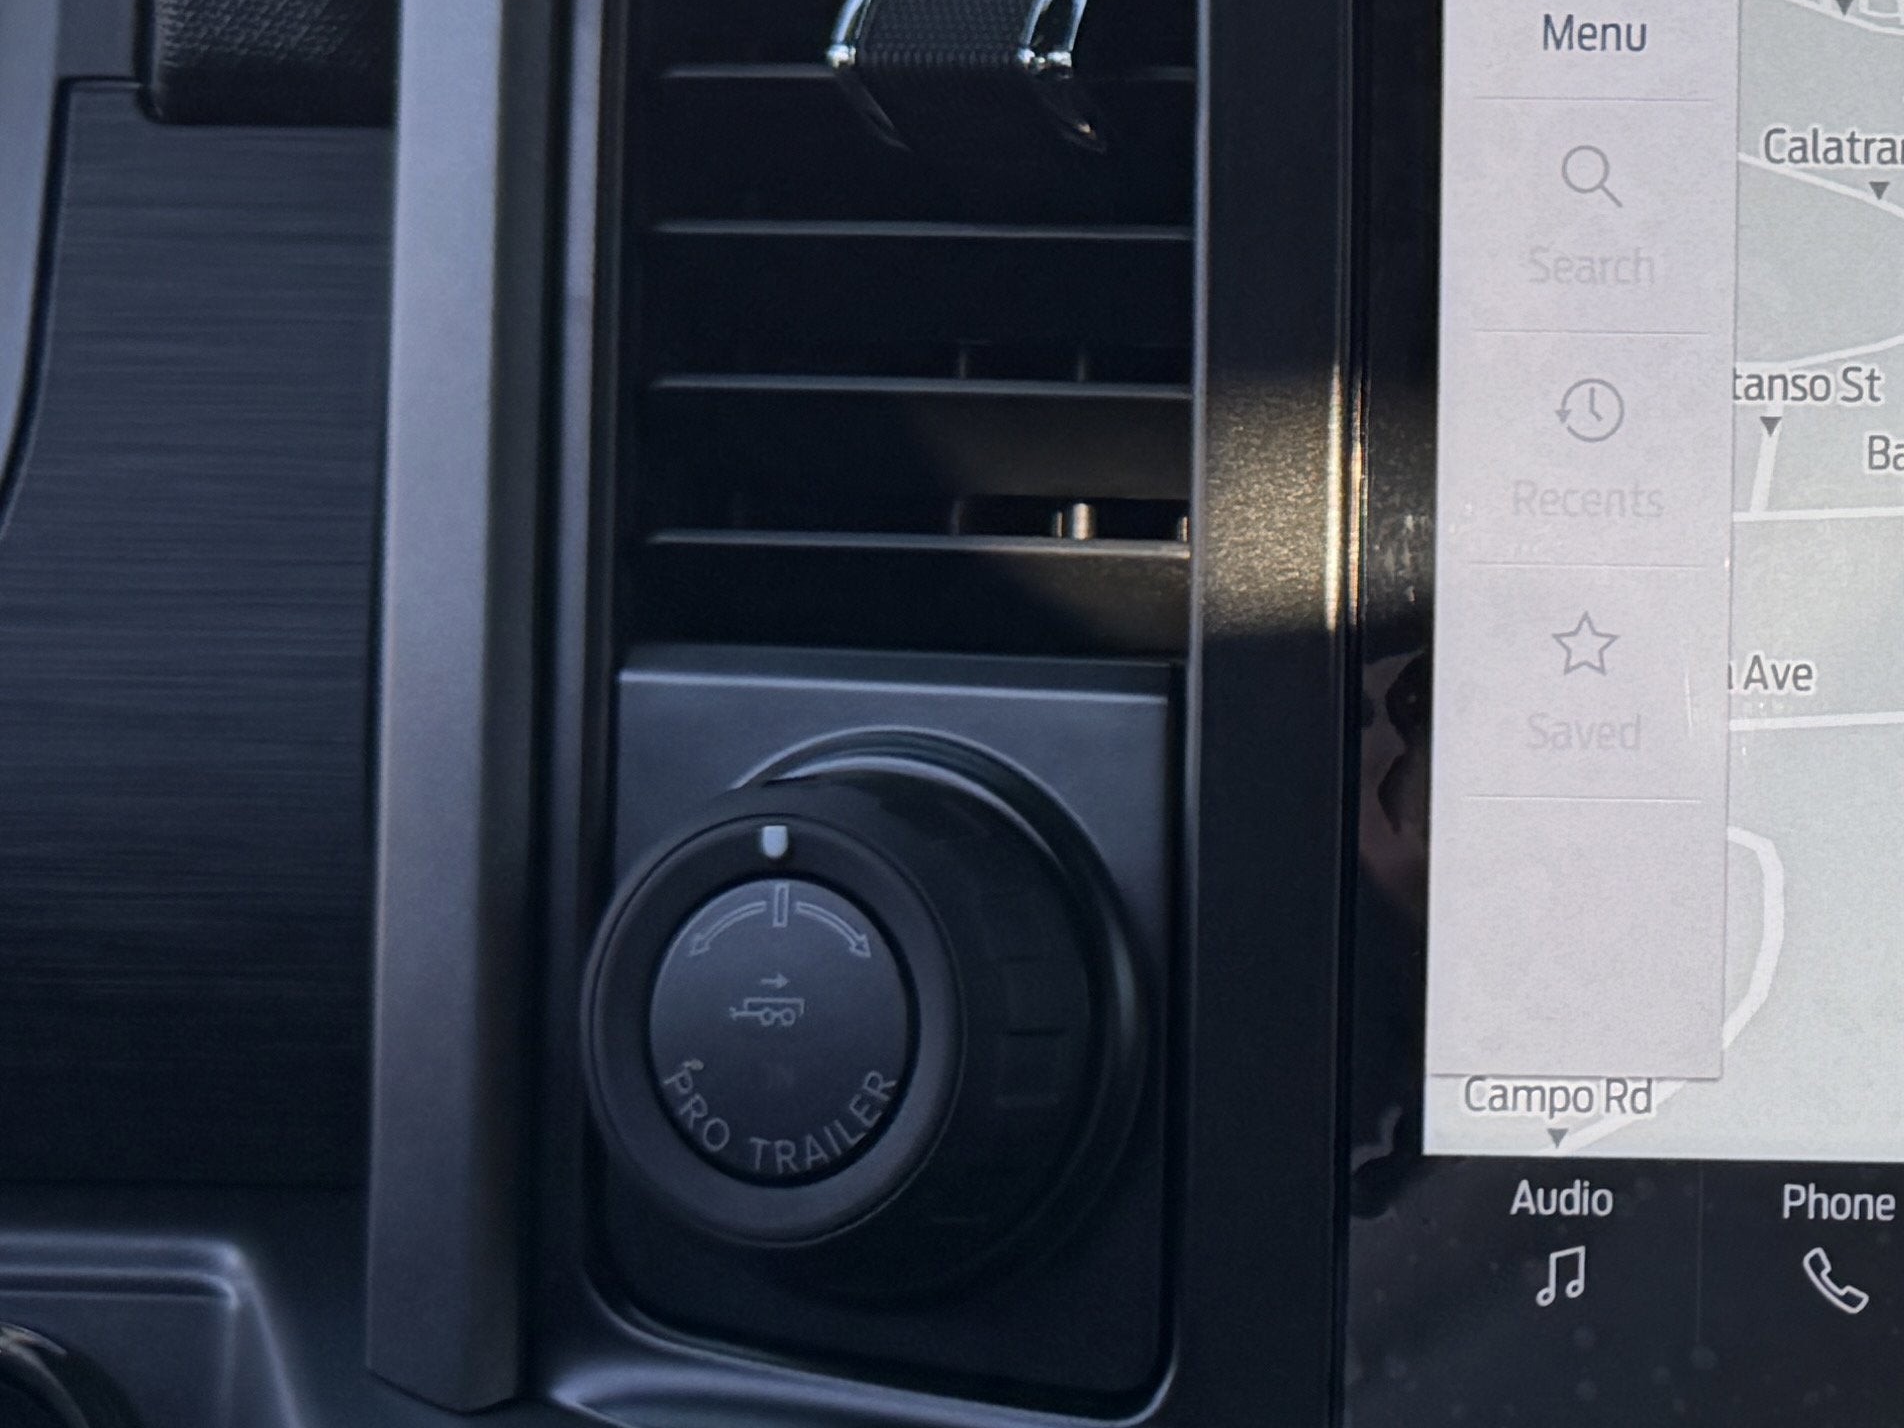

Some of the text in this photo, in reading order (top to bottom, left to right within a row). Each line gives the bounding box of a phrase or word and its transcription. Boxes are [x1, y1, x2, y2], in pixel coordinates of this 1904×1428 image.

[1542, 15, 1647, 51] Menu
[1527, 247, 1655, 285] Search
[1841, 366, 1882, 402] St
[1512, 479, 1662, 519] Recents
[1743, 654, 1813, 691] Ave
[1527, 713, 1641, 750] Saved
[1464, 1076, 1653, 1118] Campo Rd
[663, 1070, 897, 1174] PRO TRAILER
[1511, 1179, 1614, 1217] Audio
[1782, 1183, 1896, 1221] Phone
